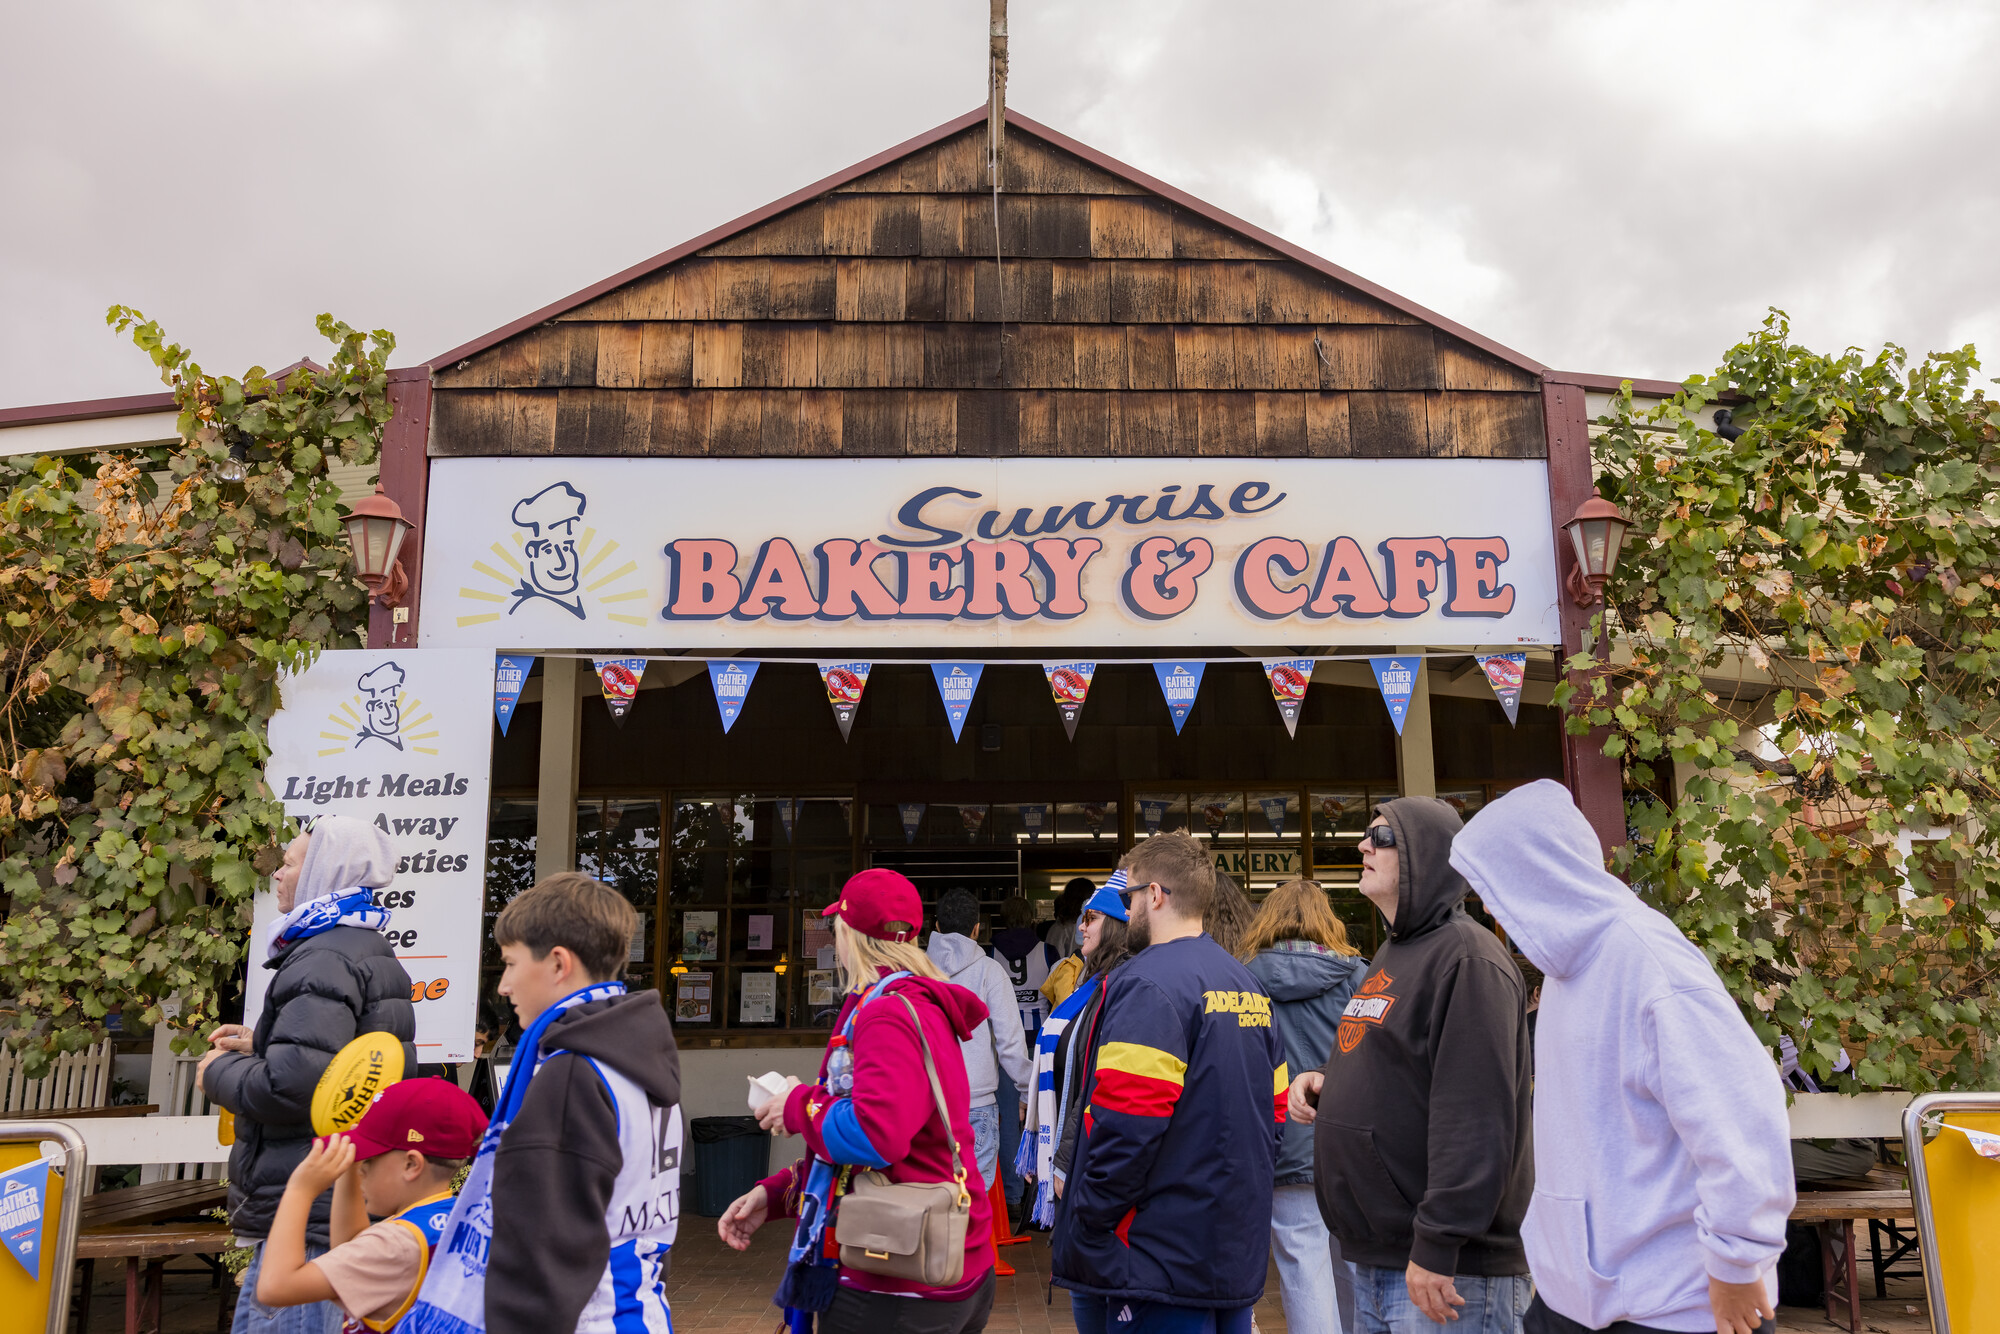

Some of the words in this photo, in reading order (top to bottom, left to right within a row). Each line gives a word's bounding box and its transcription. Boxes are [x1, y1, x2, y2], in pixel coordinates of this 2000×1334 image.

[876, 481, 1287, 548] Sunrise
[662, 537, 1101, 620] BAKERY
[1121, 536, 1214, 620] &
[1234, 536, 1515, 619] CAFE
[717, 674, 747, 686] GATHER
[943, 677, 972, 689] GATHER
[1165, 676, 1195, 688] GATHER
[1382, 671, 1411, 683] GATHER
[718, 685, 745, 697] ROUND
[1167, 687, 1194, 699] ROUND
[1384, 682, 1410, 694] ROUND
[944, 689, 971, 700] ROUND
[282, 775, 371, 804] Light
[377, 772, 469, 797] Meals
[385, 929, 418, 949] ee
[331, 1050, 384, 1129] SHERRIN
[0, 1203, 41, 1232] ROUND
[619, 1188, 680, 1236] MAZ
